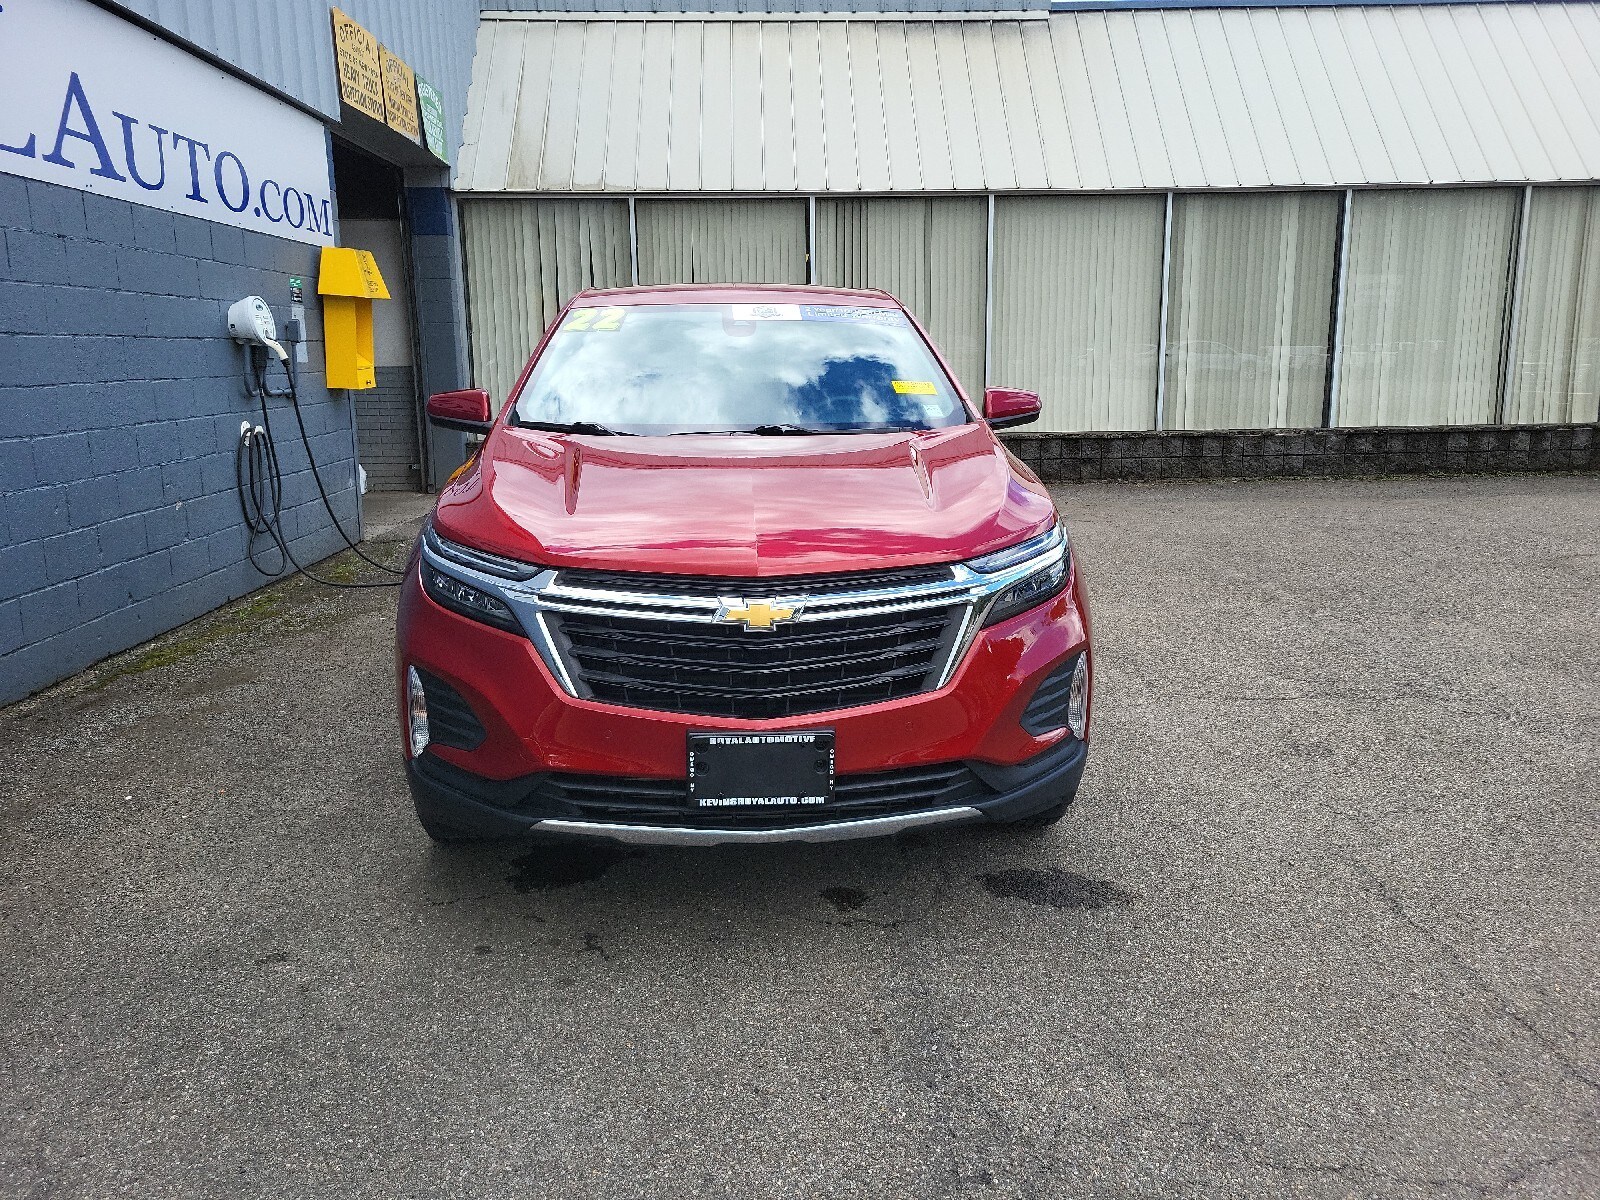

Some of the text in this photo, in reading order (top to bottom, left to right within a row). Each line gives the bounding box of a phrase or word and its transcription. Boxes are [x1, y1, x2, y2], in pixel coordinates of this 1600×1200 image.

[339, 23, 376, 64] OFFICIAL
[562, 308, 627, 332] 22
[699, 796, 825, 807] KEVINSROYALAUTO.COM
